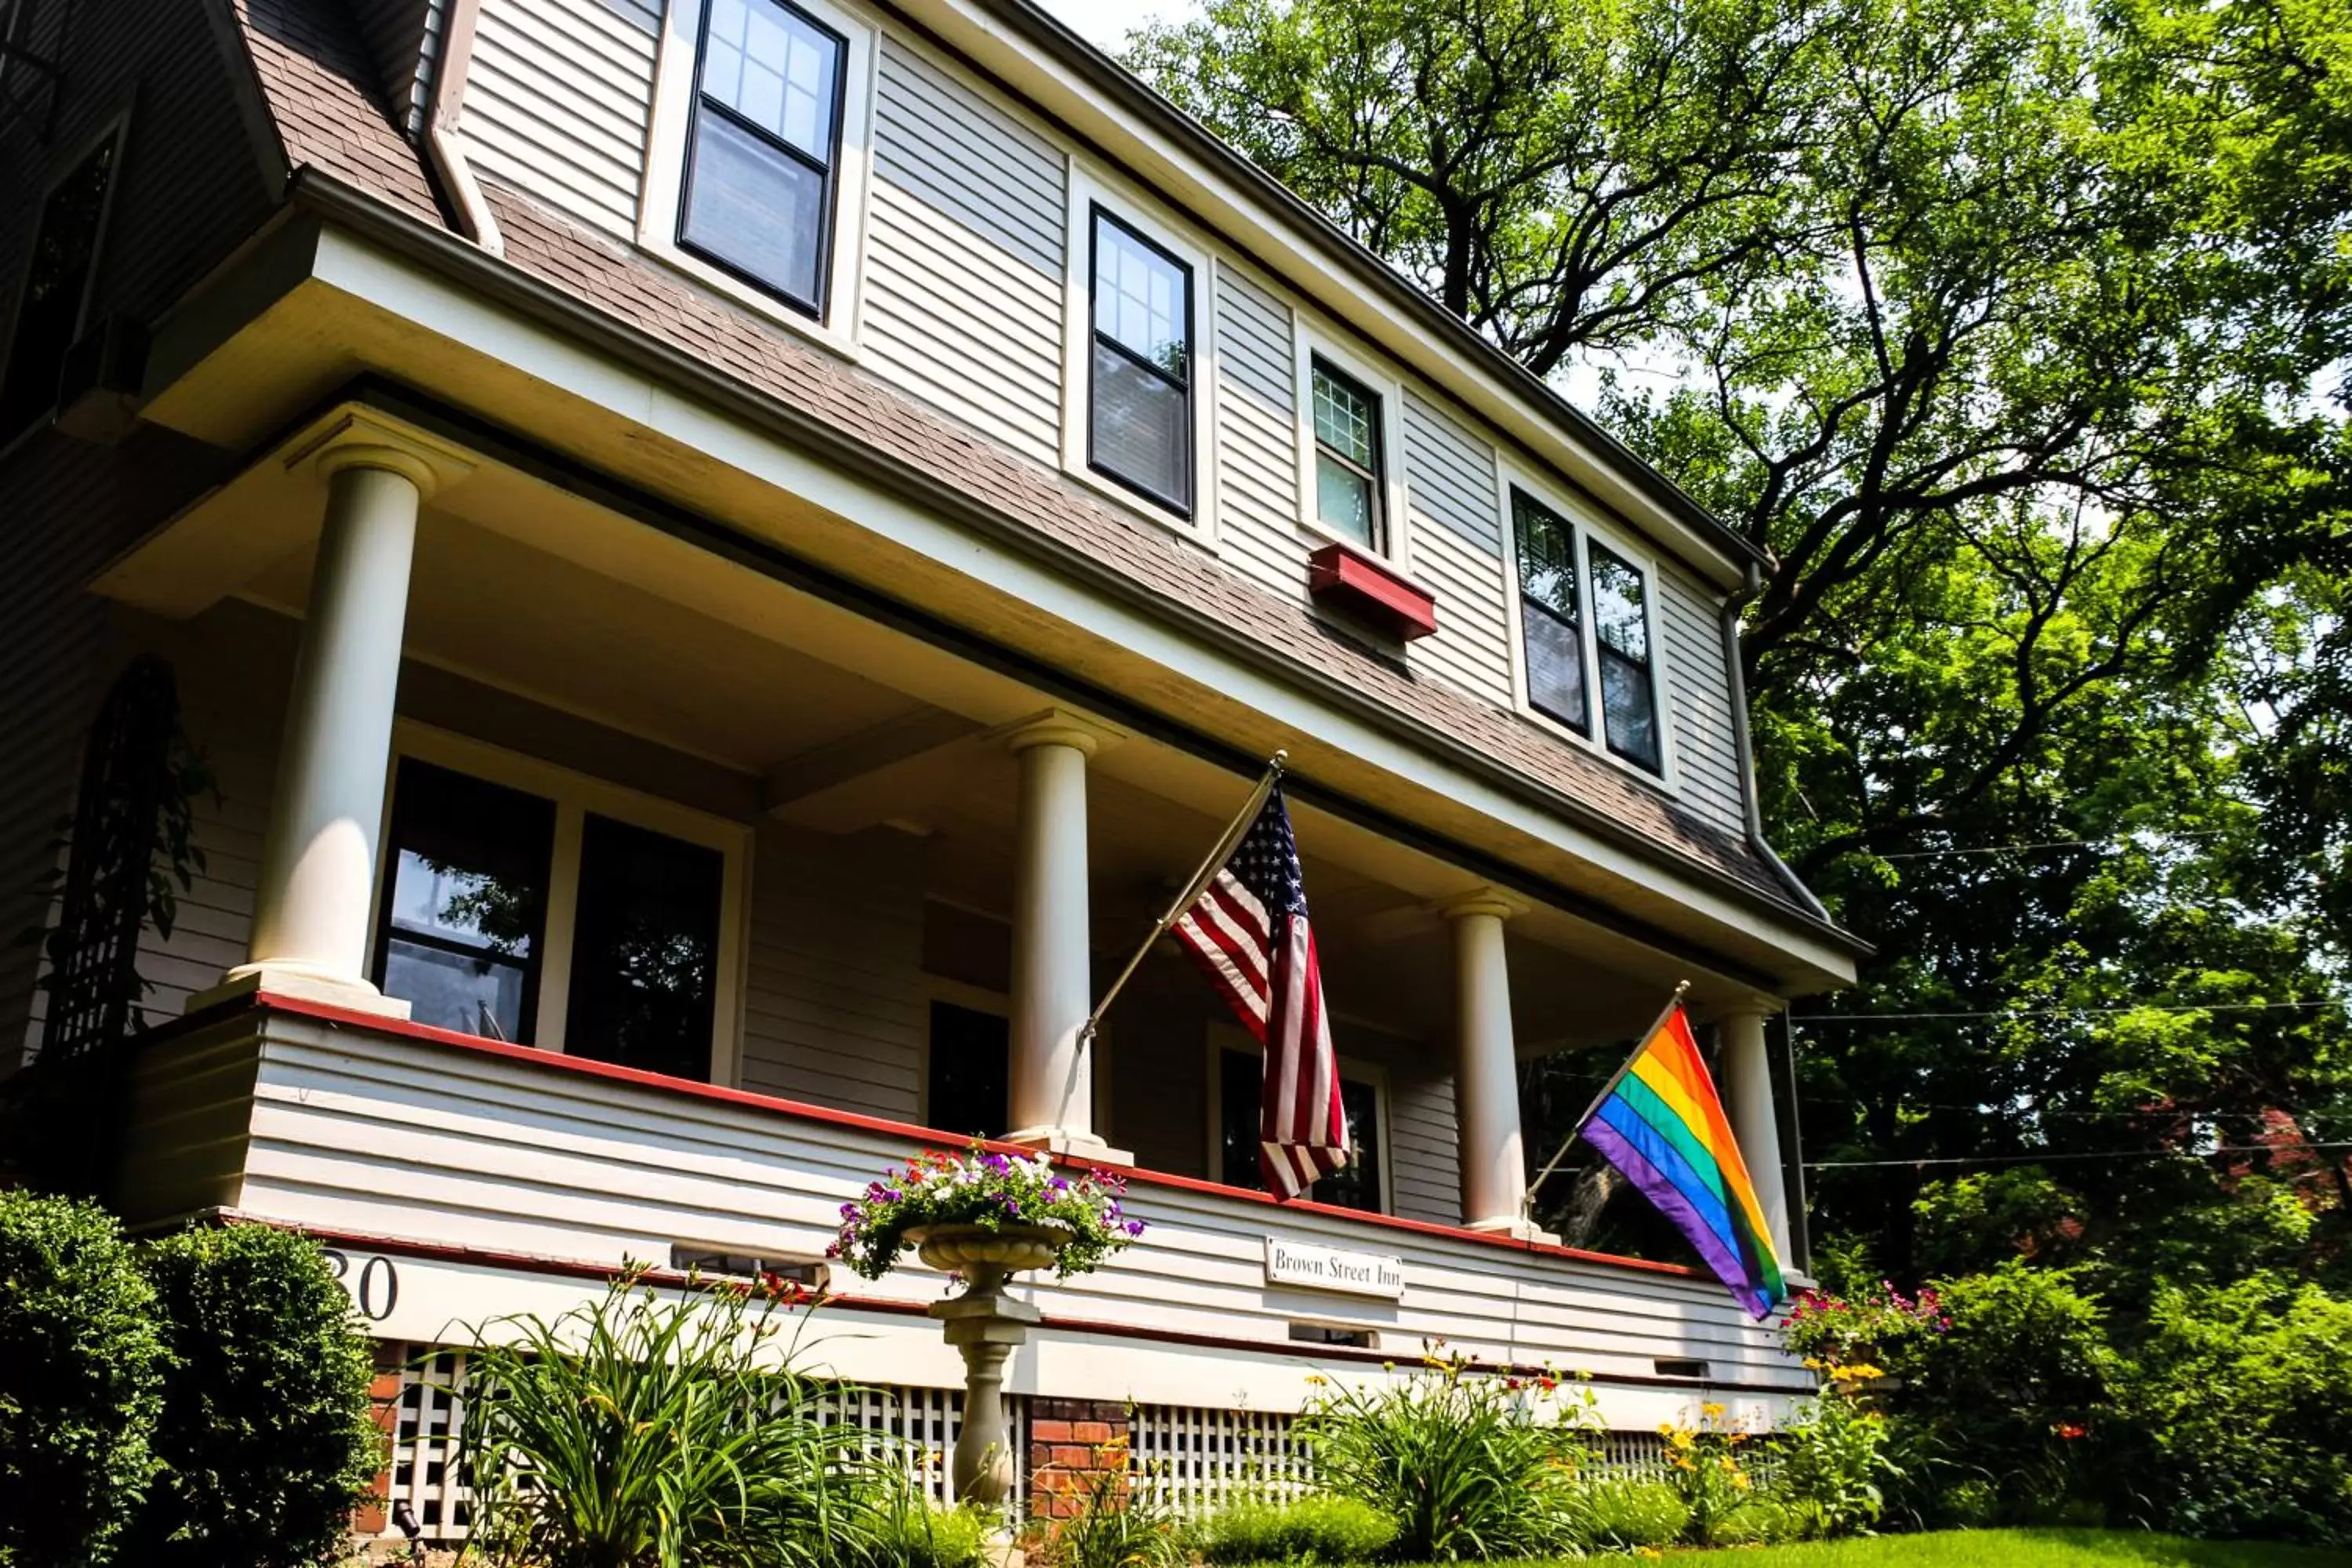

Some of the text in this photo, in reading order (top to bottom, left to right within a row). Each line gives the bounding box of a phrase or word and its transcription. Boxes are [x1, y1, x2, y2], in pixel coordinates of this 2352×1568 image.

[1276, 1248, 1399, 1286] Brown Street Inn
